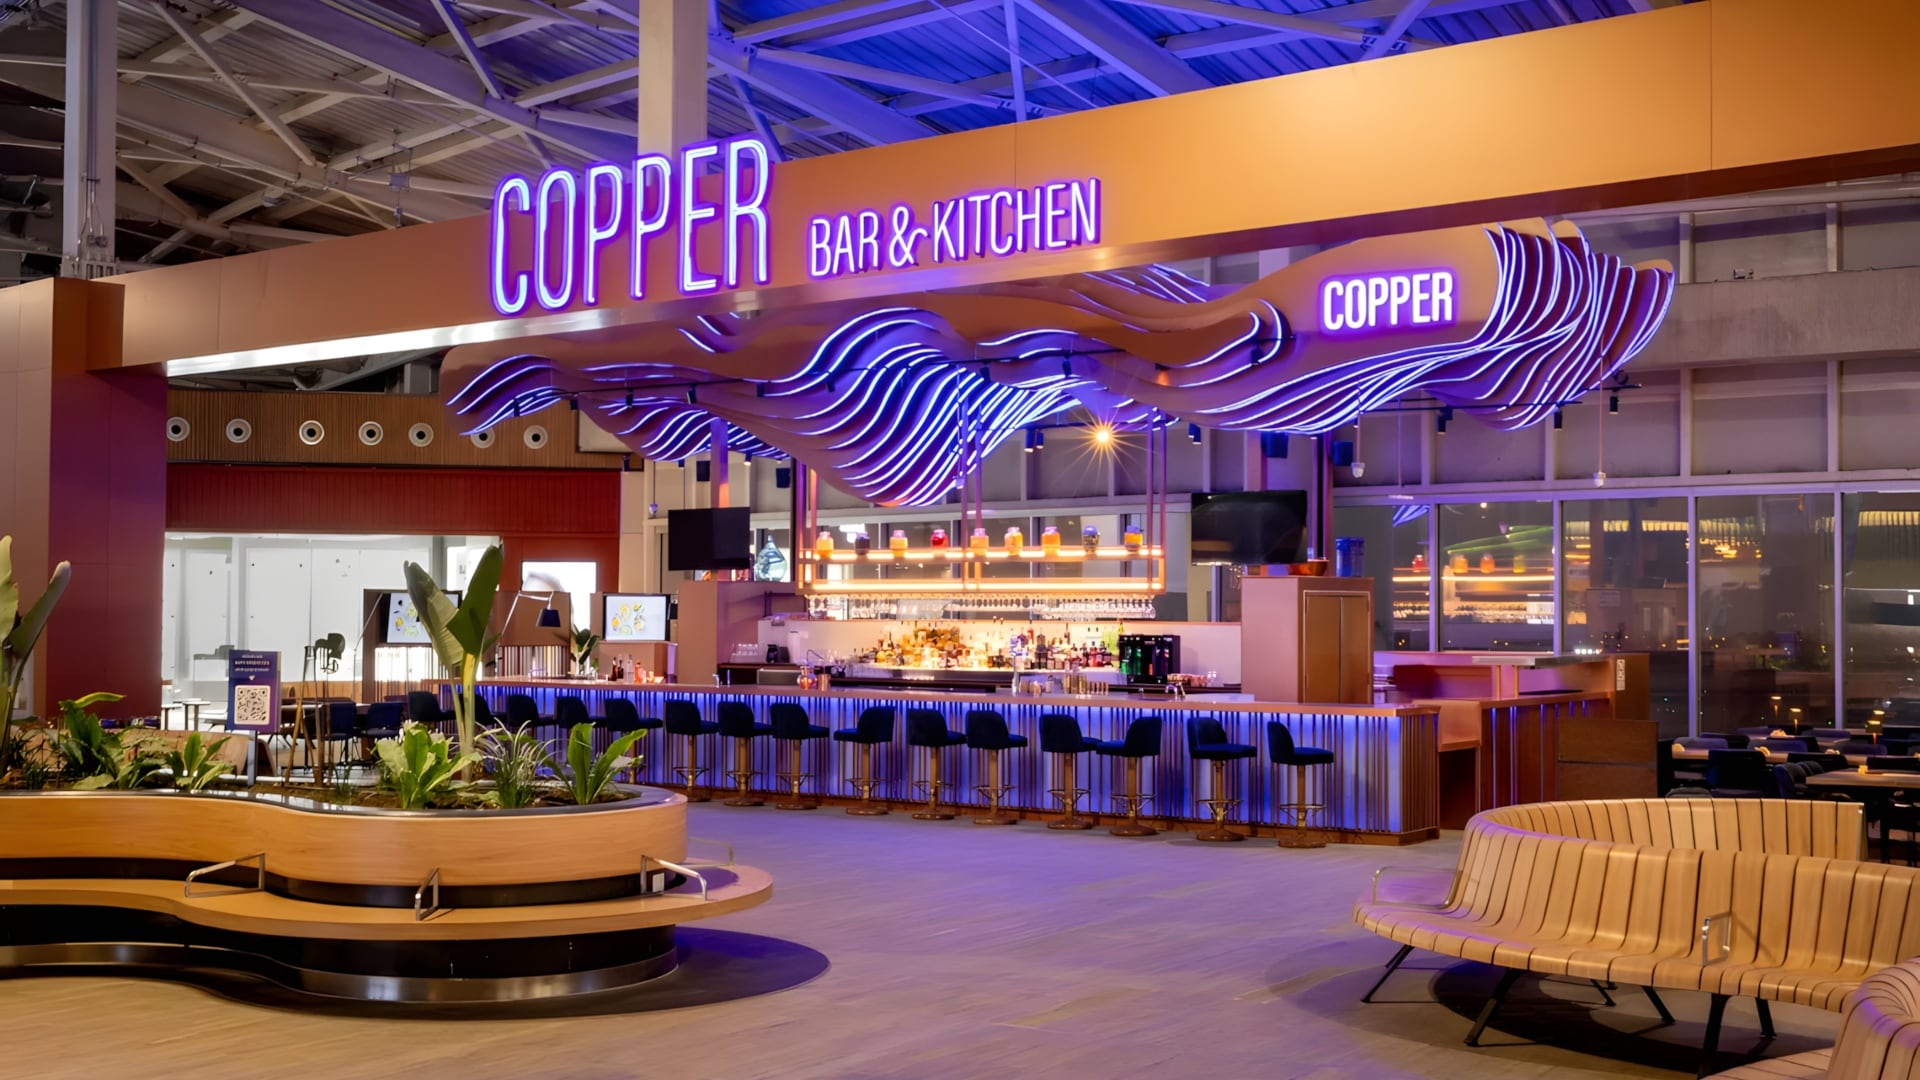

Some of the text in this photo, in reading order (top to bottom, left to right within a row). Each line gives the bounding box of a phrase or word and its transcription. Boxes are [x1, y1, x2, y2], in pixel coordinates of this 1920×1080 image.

[493, 138, 769, 315] COPPER
[810, 177, 1101, 278] BAR & KITCHEN
[1323, 271, 1454, 331] COPPER
